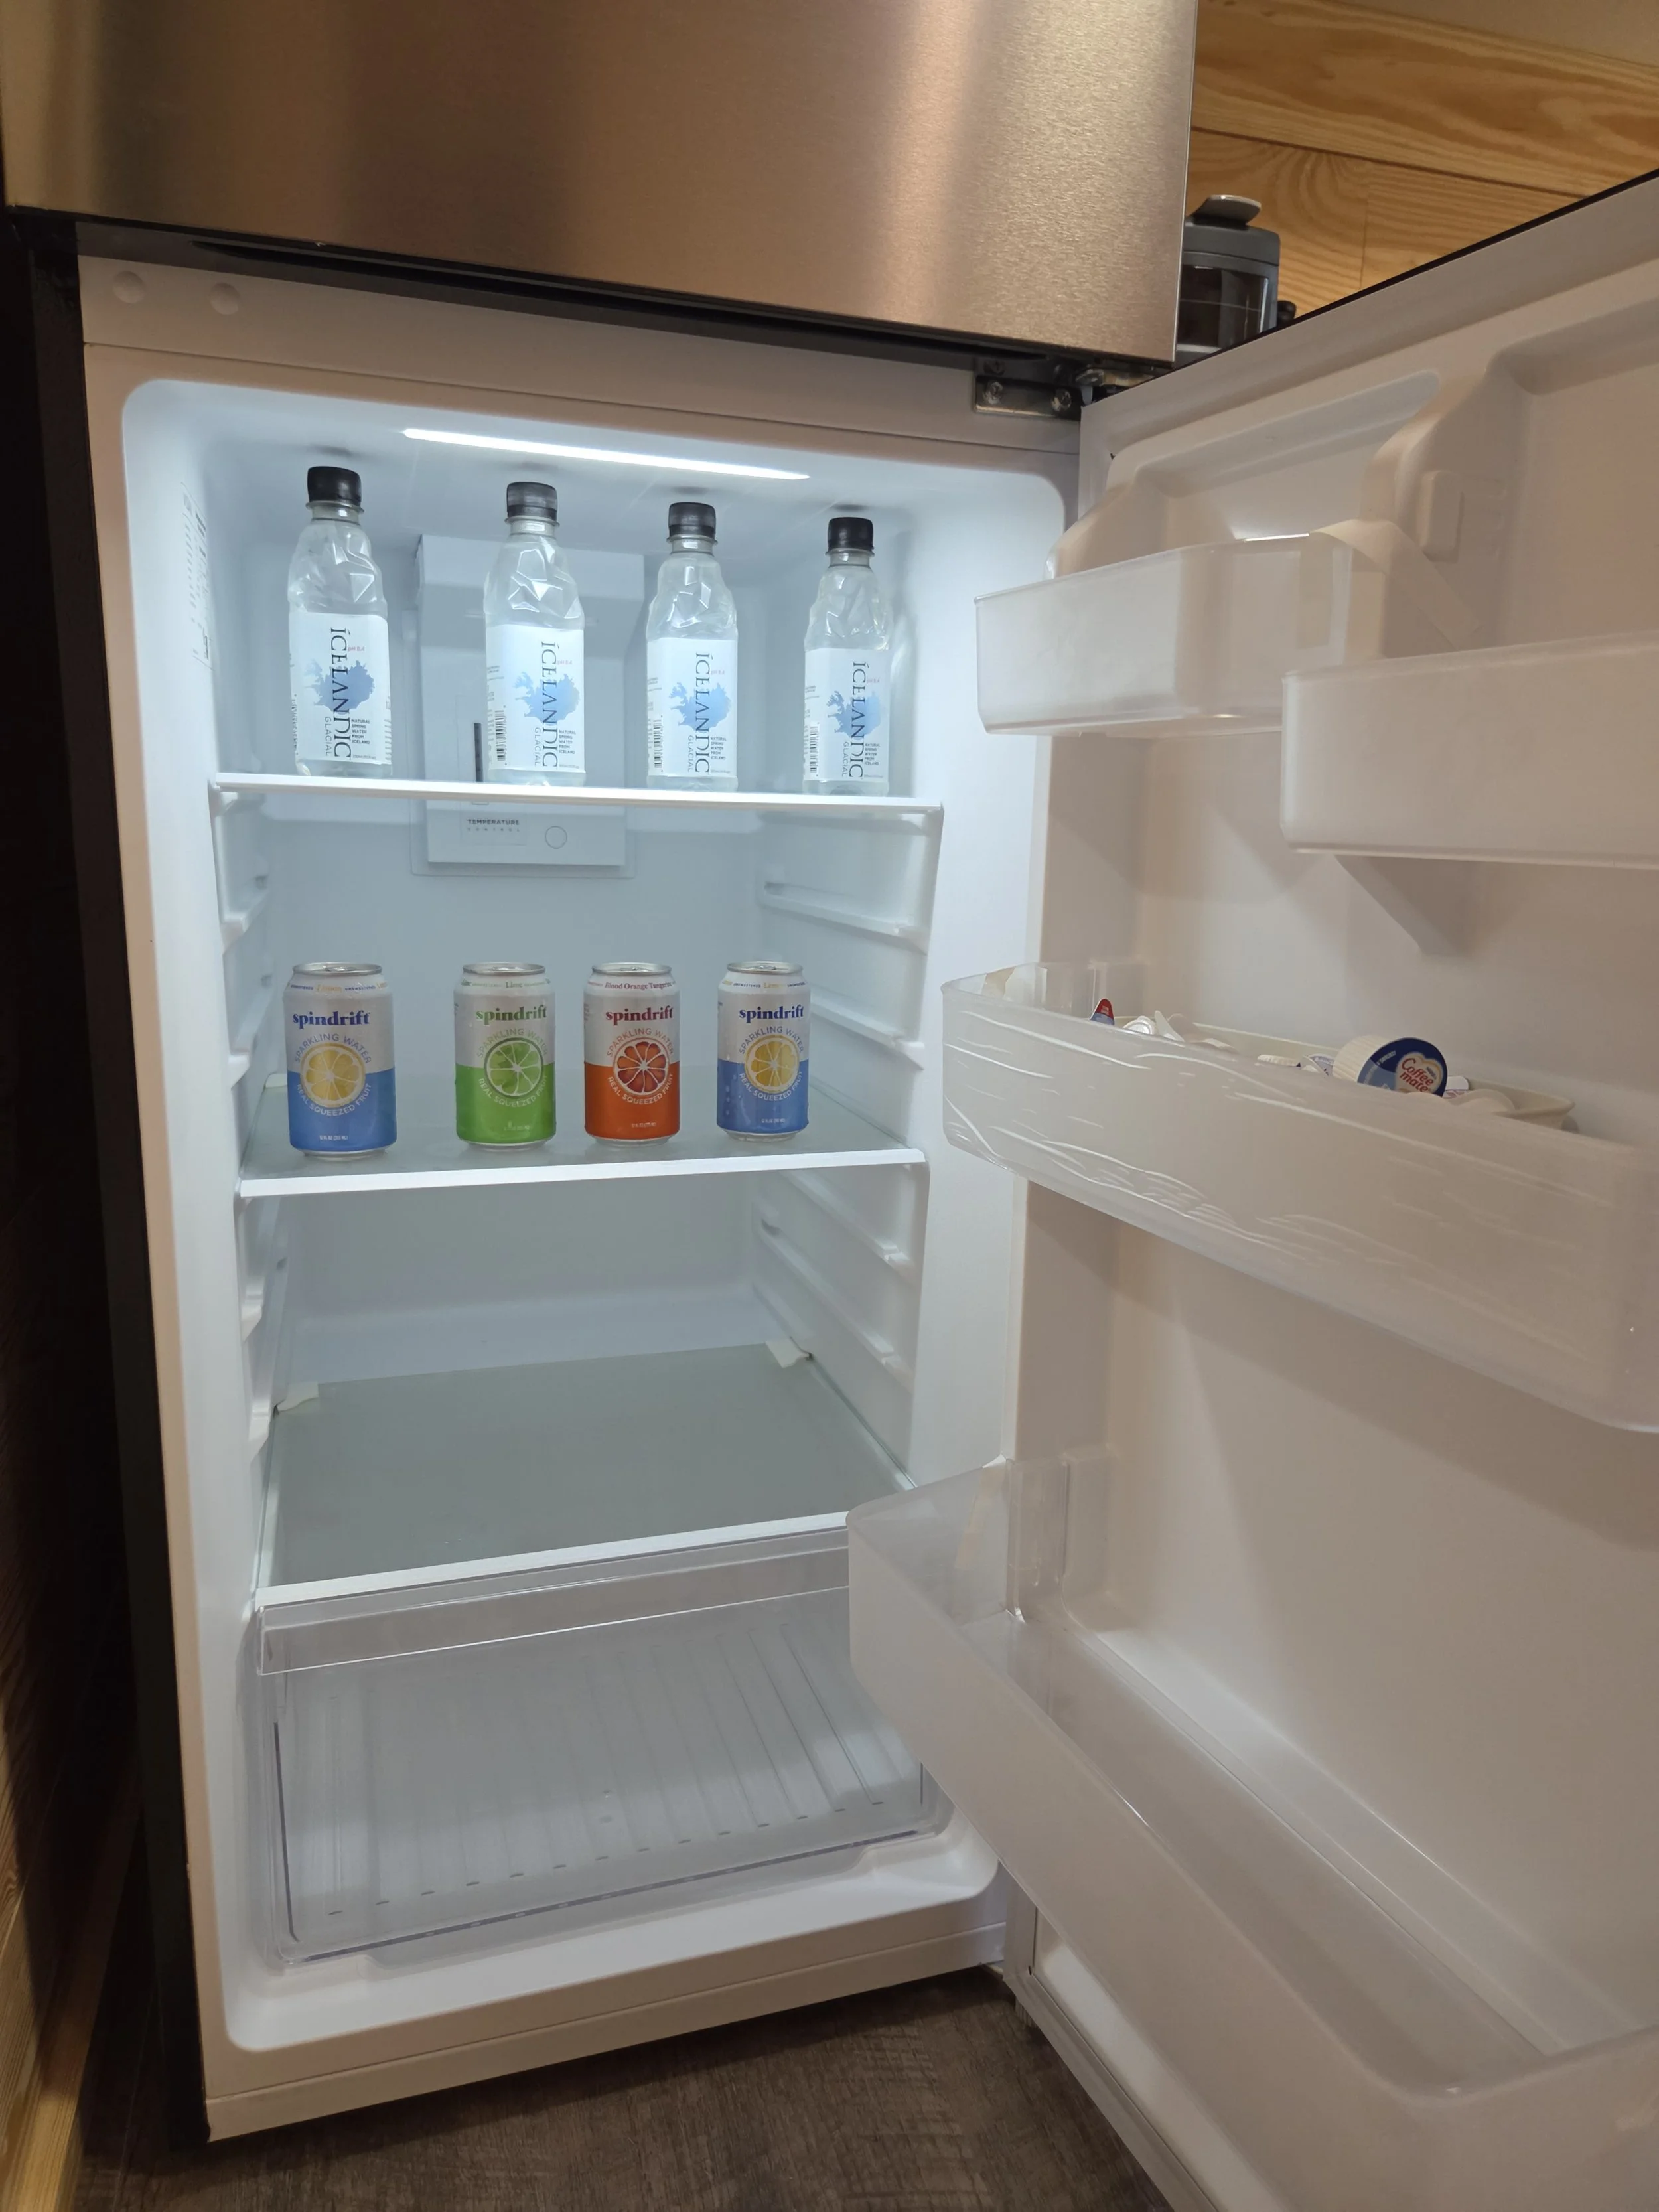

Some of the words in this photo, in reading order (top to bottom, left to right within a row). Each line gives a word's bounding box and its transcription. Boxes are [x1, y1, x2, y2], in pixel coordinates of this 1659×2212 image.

[293, 1009, 370, 1029] spindrift
[476, 1005, 547, 1025] spindrift
[605, 1005, 674, 1025] spindrift
[739, 1004, 804, 1023] spindrift
[295, 1033, 340, 1062] SPARKLING
[343, 1035, 372, 1064] WATER
[476, 1028, 524, 1058] SPARKLING
[528, 1030, 548, 1056] WATER
[607, 1027, 652, 1057] SPARKLING
[655, 1029, 674, 1055] WATER
[739, 1026, 783, 1055] SPARKLING
[785, 1028, 804, 1053] WATER
[739, 1072, 753, 1093] REAL
[753, 1090, 792, 1102] SQUEEZED
[792, 1070, 803, 1092] FRUIT
[1399, 1072, 1428, 1092] mate
[1401, 1057, 1434, 1086] Coffee
[297, 1083, 309, 1105] REAL
[309, 1104, 356, 1117] SQUEEZED
[355, 1082, 372, 1106] FRUIT
[478, 1077, 492, 1099] REAL
[493, 1095, 536, 1108] SQUEEZED
[607, 1076, 621, 1097] REAL
[622, 1093, 662, 1105] SQUEEZED
[662, 1072, 674, 1095] FRUIT
